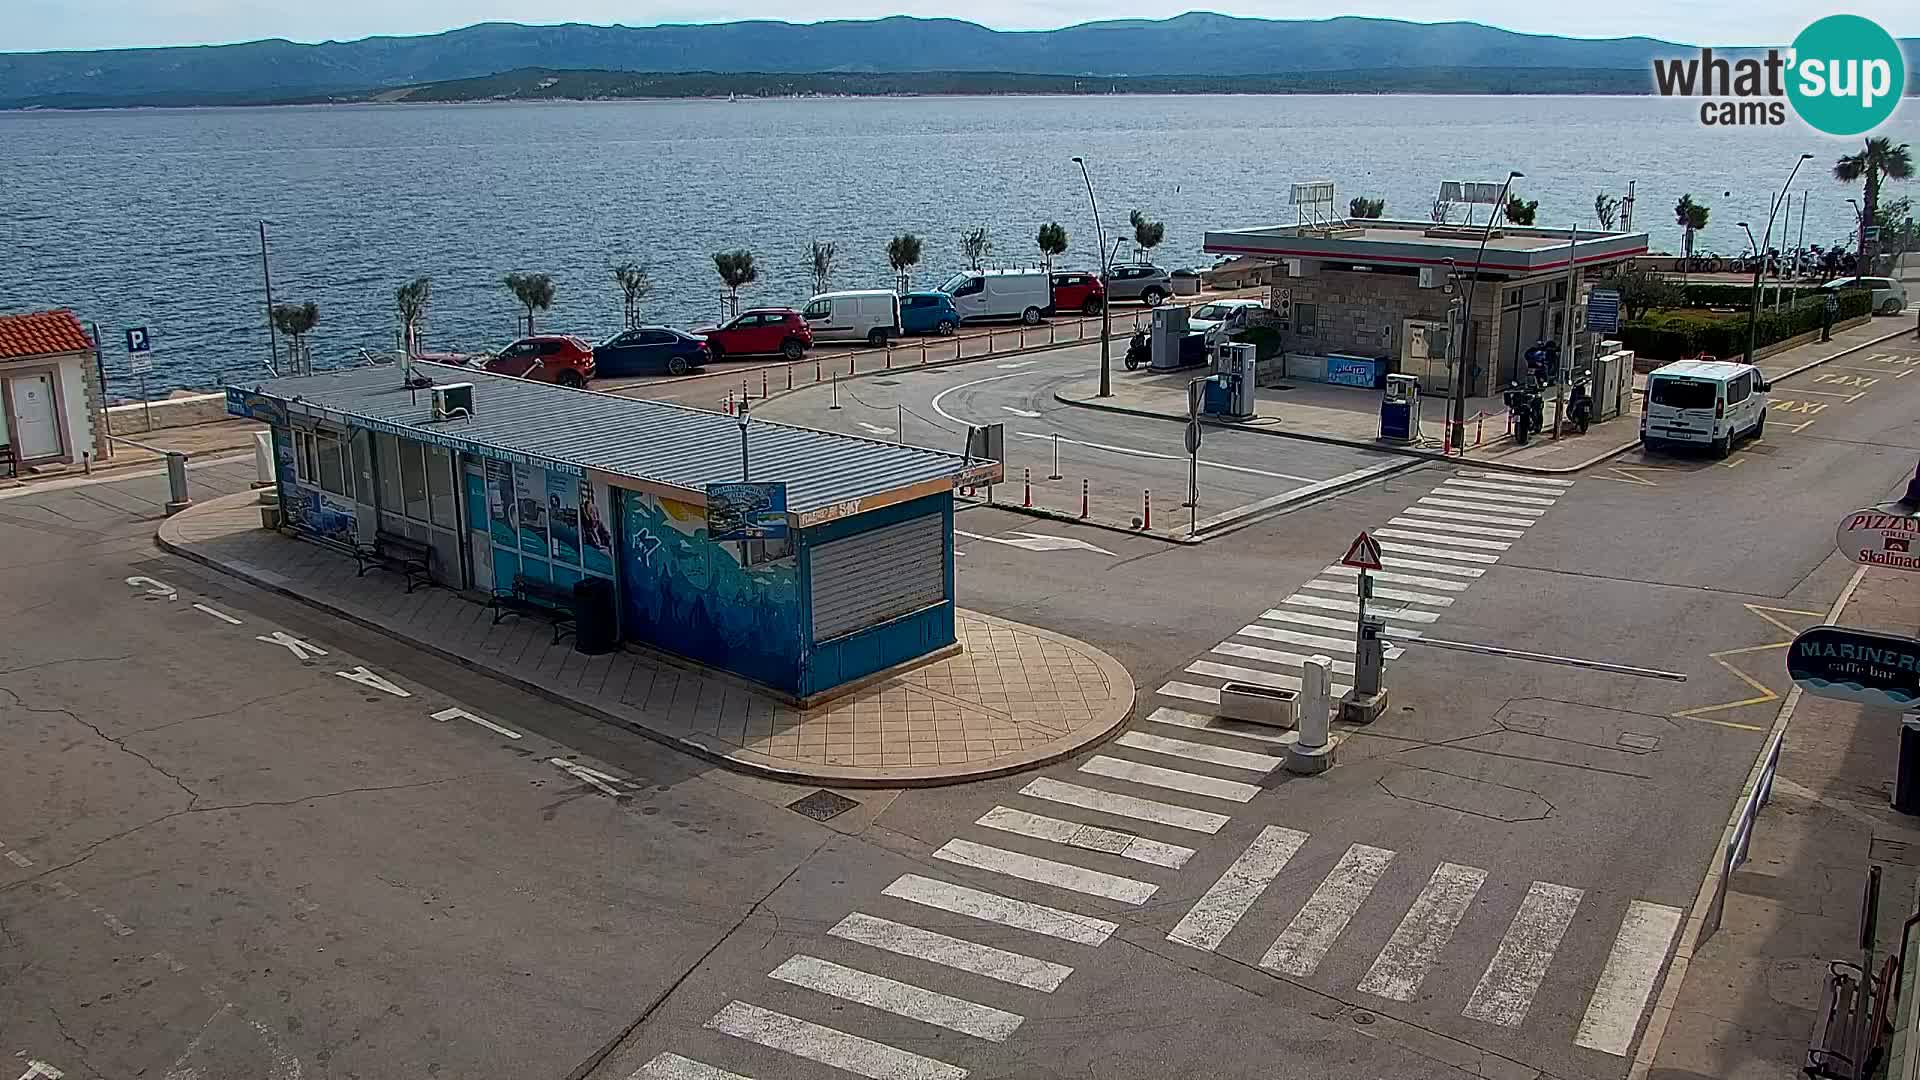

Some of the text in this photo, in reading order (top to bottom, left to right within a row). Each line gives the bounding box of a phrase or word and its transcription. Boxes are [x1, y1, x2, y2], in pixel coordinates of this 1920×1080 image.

[131, 331, 144, 349] P
[1814, 373, 1880, 388] TAXI
[1766, 398, 1829, 414] TAXI
[437, 436, 469, 452] POSTAJA
[479, 445, 494, 457] BUS
[495, 449, 527, 465] STATION
[528, 456, 555, 471] TICKET
[556, 461, 583, 477] OFFICE
[1848, 514, 1920, 534] PIZZE
[1880, 529, 1917, 541] GRILL
[1869, 664, 1896, 680] bar
